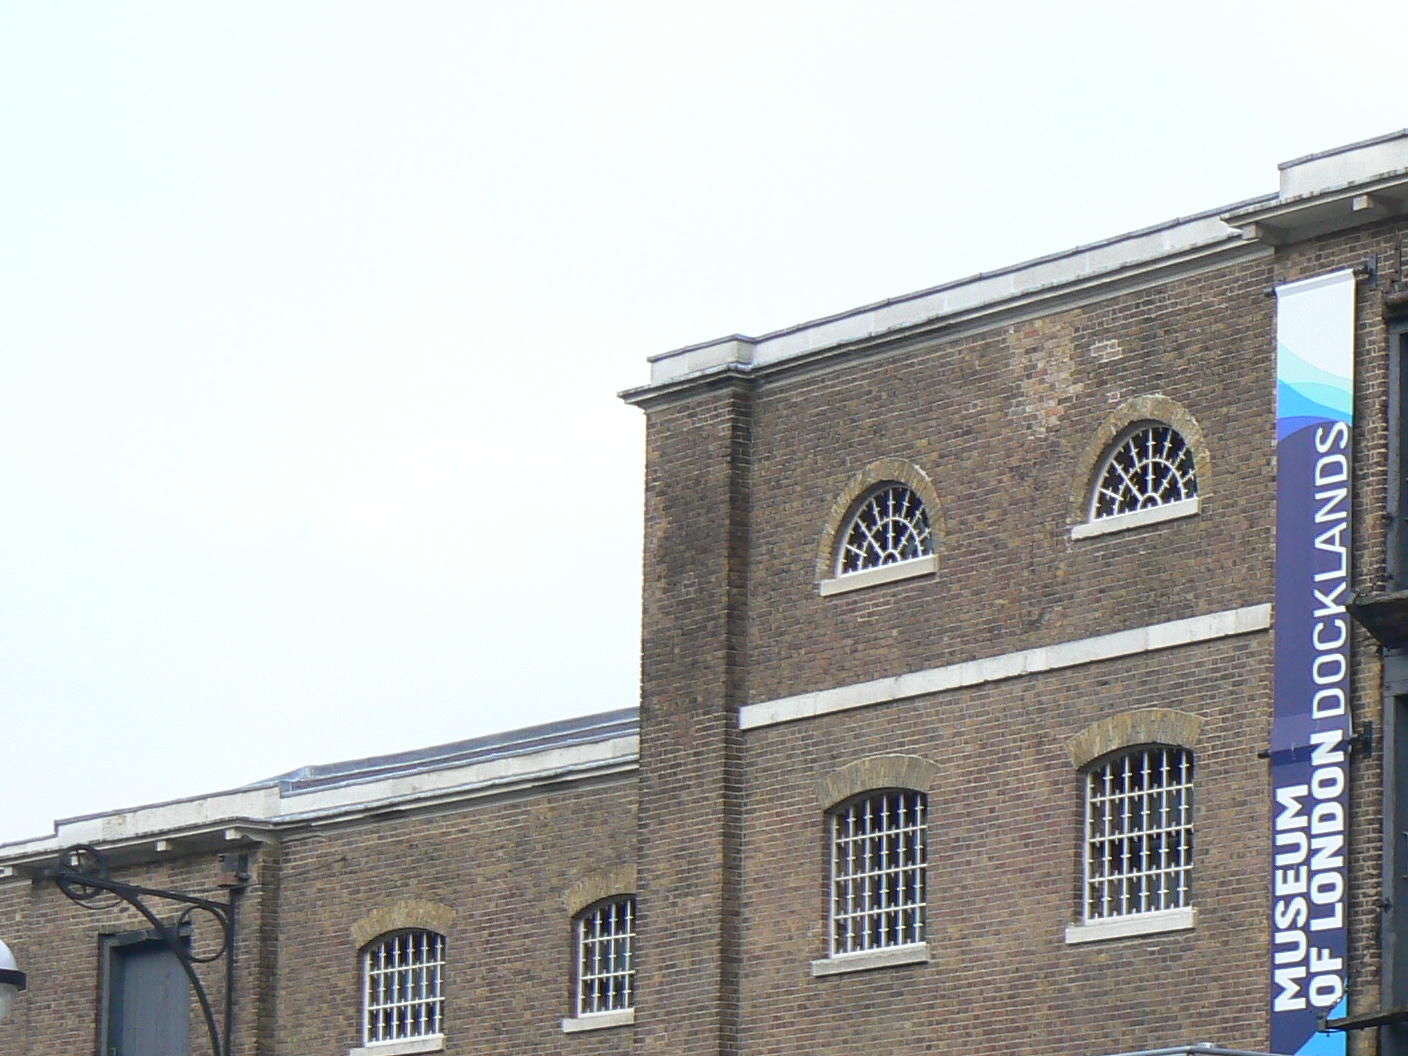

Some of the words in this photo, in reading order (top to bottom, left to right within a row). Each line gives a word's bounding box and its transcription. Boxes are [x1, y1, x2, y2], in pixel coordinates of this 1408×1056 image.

[1311, 420, 1349, 720] DOCKLANDS
[1273, 784, 1309, 1012] MUSEUM
[1309, 729, 1345, 932] LONDON
[1308, 946, 1344, 1008] OF
